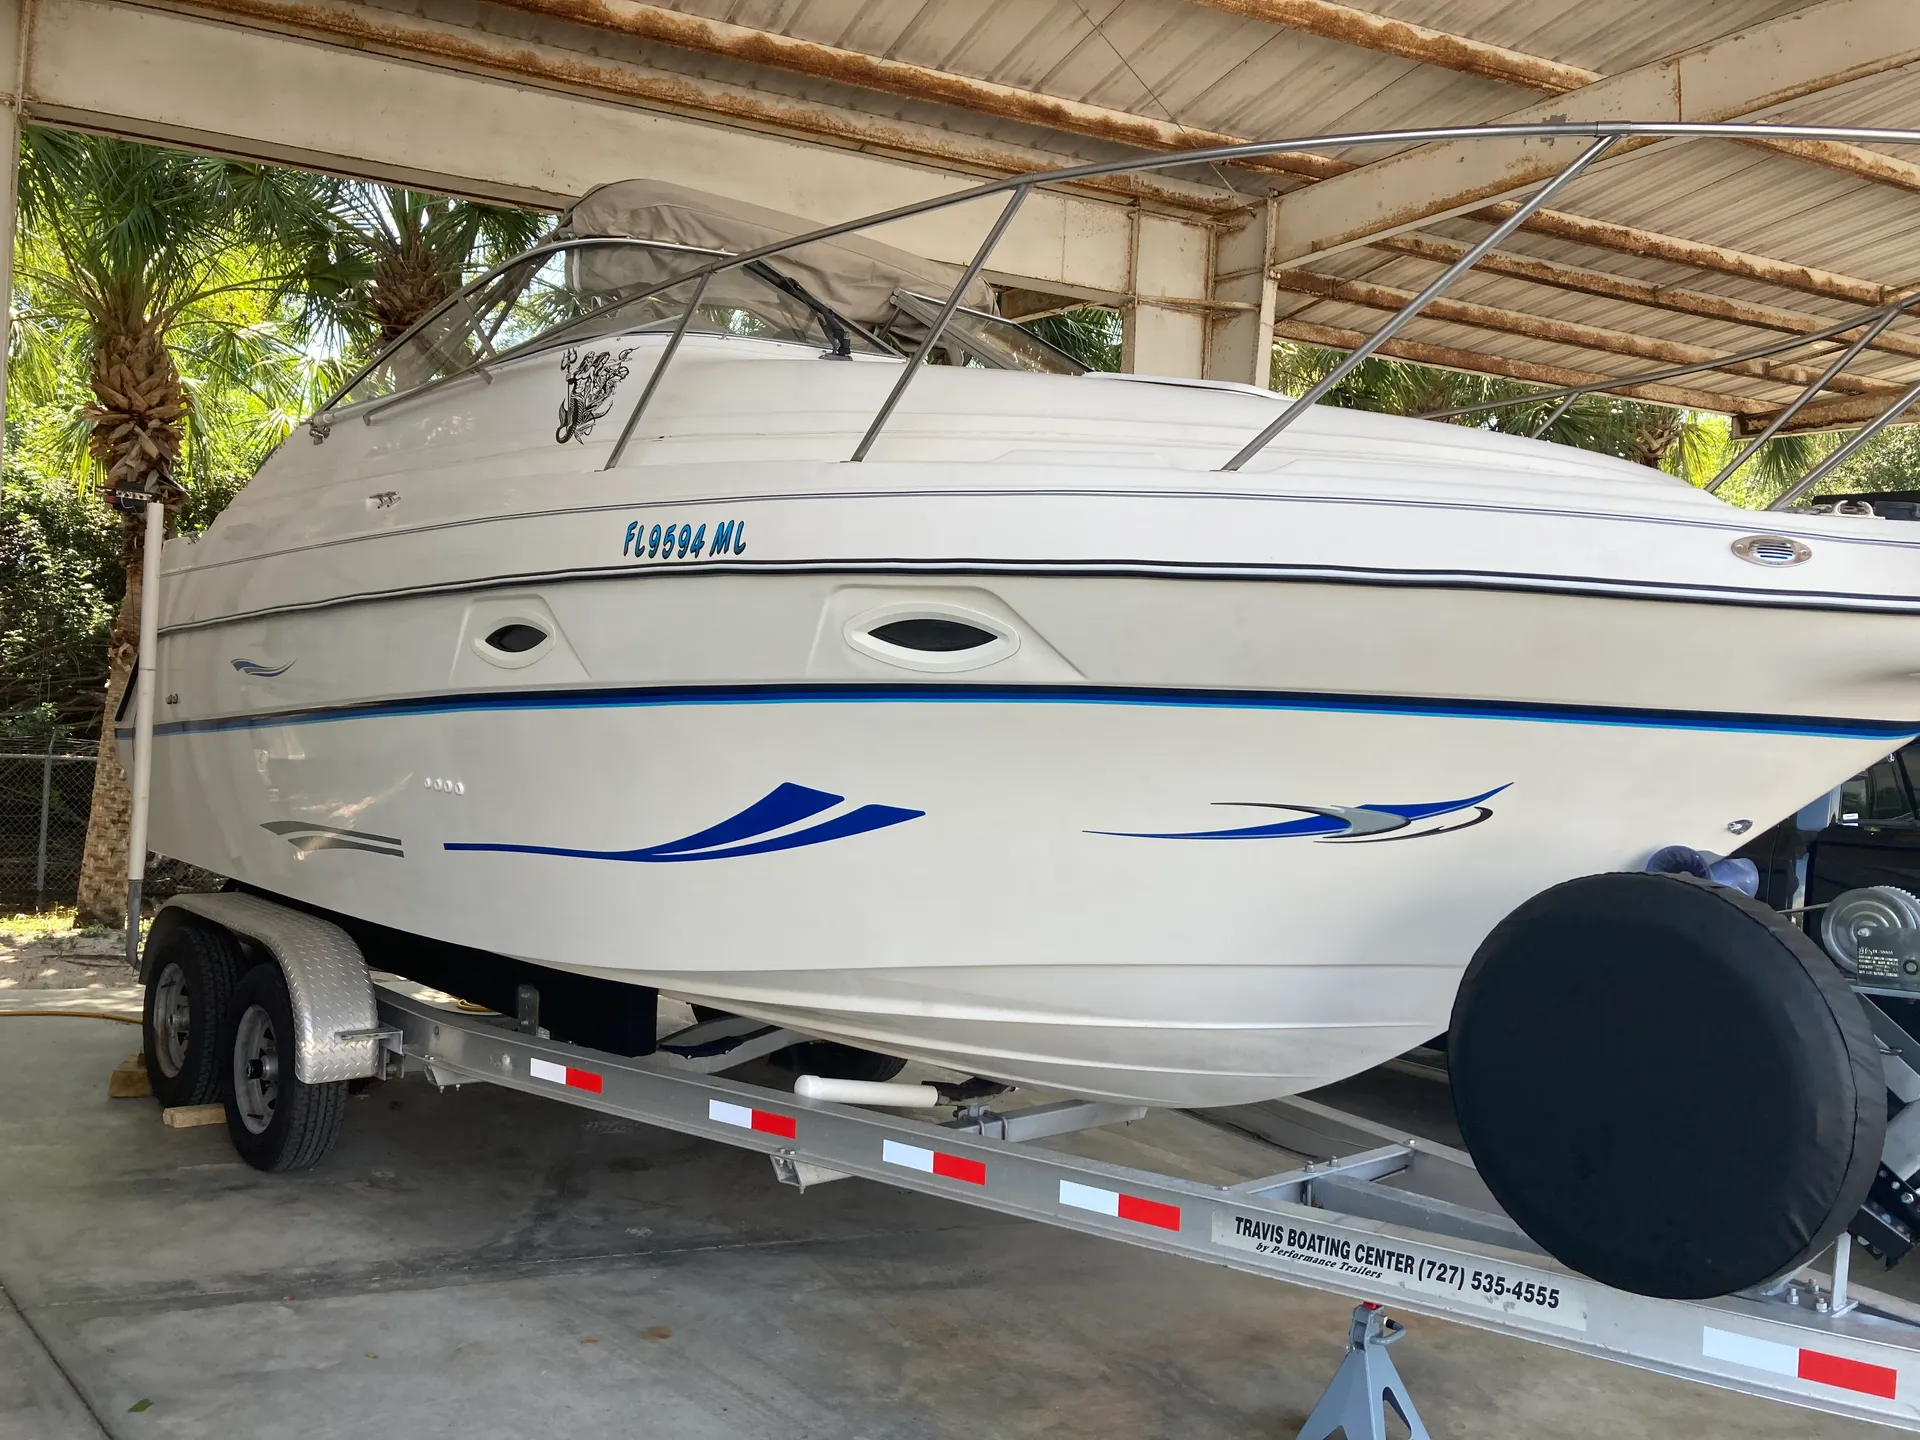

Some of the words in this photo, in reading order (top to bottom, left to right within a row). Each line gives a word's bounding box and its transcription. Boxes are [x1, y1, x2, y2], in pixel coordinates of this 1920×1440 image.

[709, 519, 747, 557] ML
[1235, 1216, 1284, 1244] TRAVIS
[1287, 1228, 1351, 1260] BOATING
[1354, 1243, 1414, 1275] CENTER
[1418, 1258, 1465, 1290] (727)
[1471, 1271, 1560, 1309] 535-4555
[1256, 1242, 1270, 1252] by
[1270, 1245, 1337, 1268] Performance
[1339, 1261, 1383, 1279] Trailers
